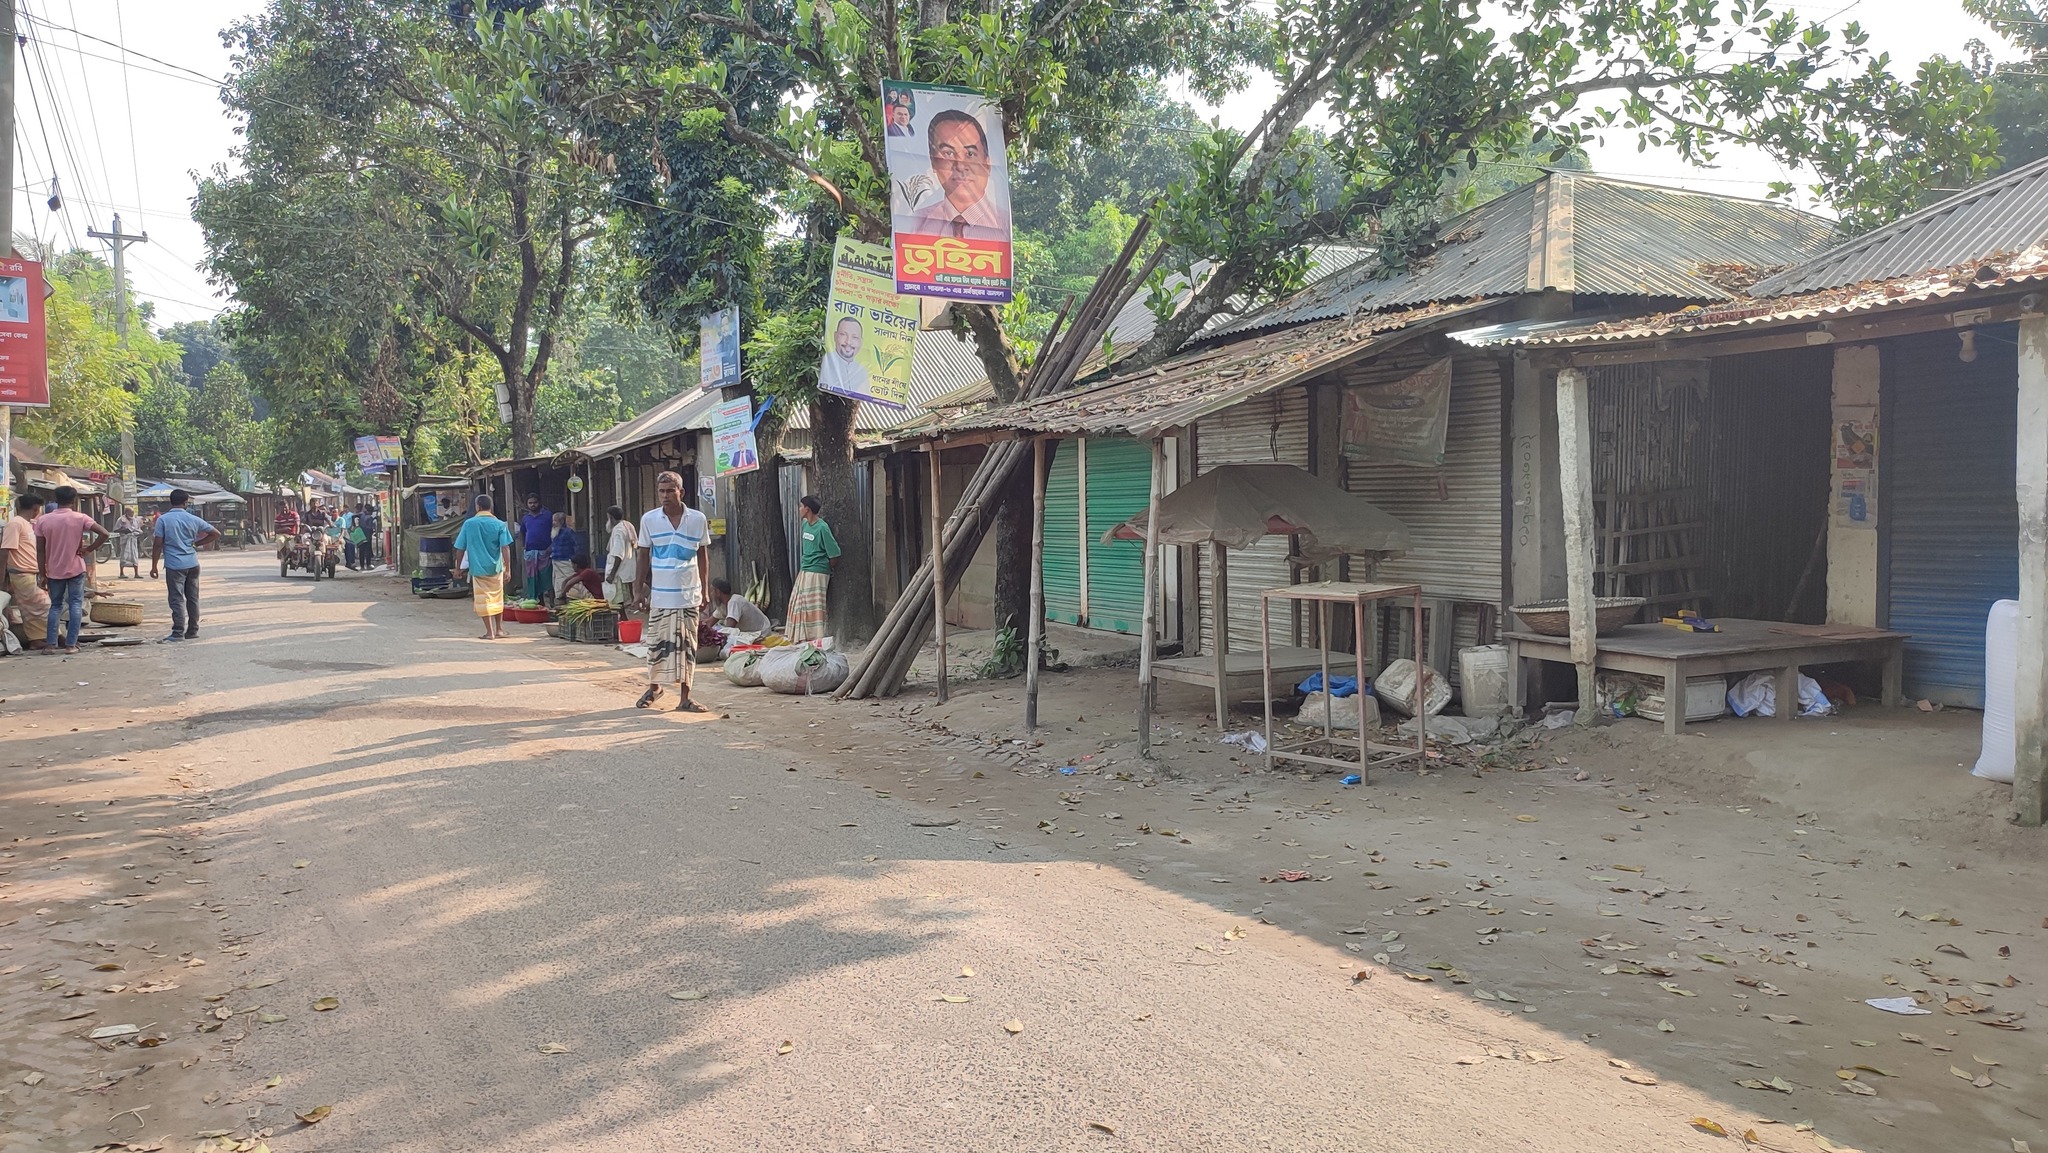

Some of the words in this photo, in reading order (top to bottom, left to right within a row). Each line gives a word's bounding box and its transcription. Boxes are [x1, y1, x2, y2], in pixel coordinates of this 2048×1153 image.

[902, 238, 1003, 275] তুহিন
[10, 263, 22, 272] রবি
[834, 299, 865, 318] রাজা
[869, 308, 918, 331] ভাইয়ের
[874, 327, 898, 340] সালাম
[900, 330, 914, 344] নিন
[872, 375, 890, 385] ধানের
[892, 377, 906, 389] শীষে
[870, 386, 889, 396] ভোট
[891, 387, 906, 400] দিন
